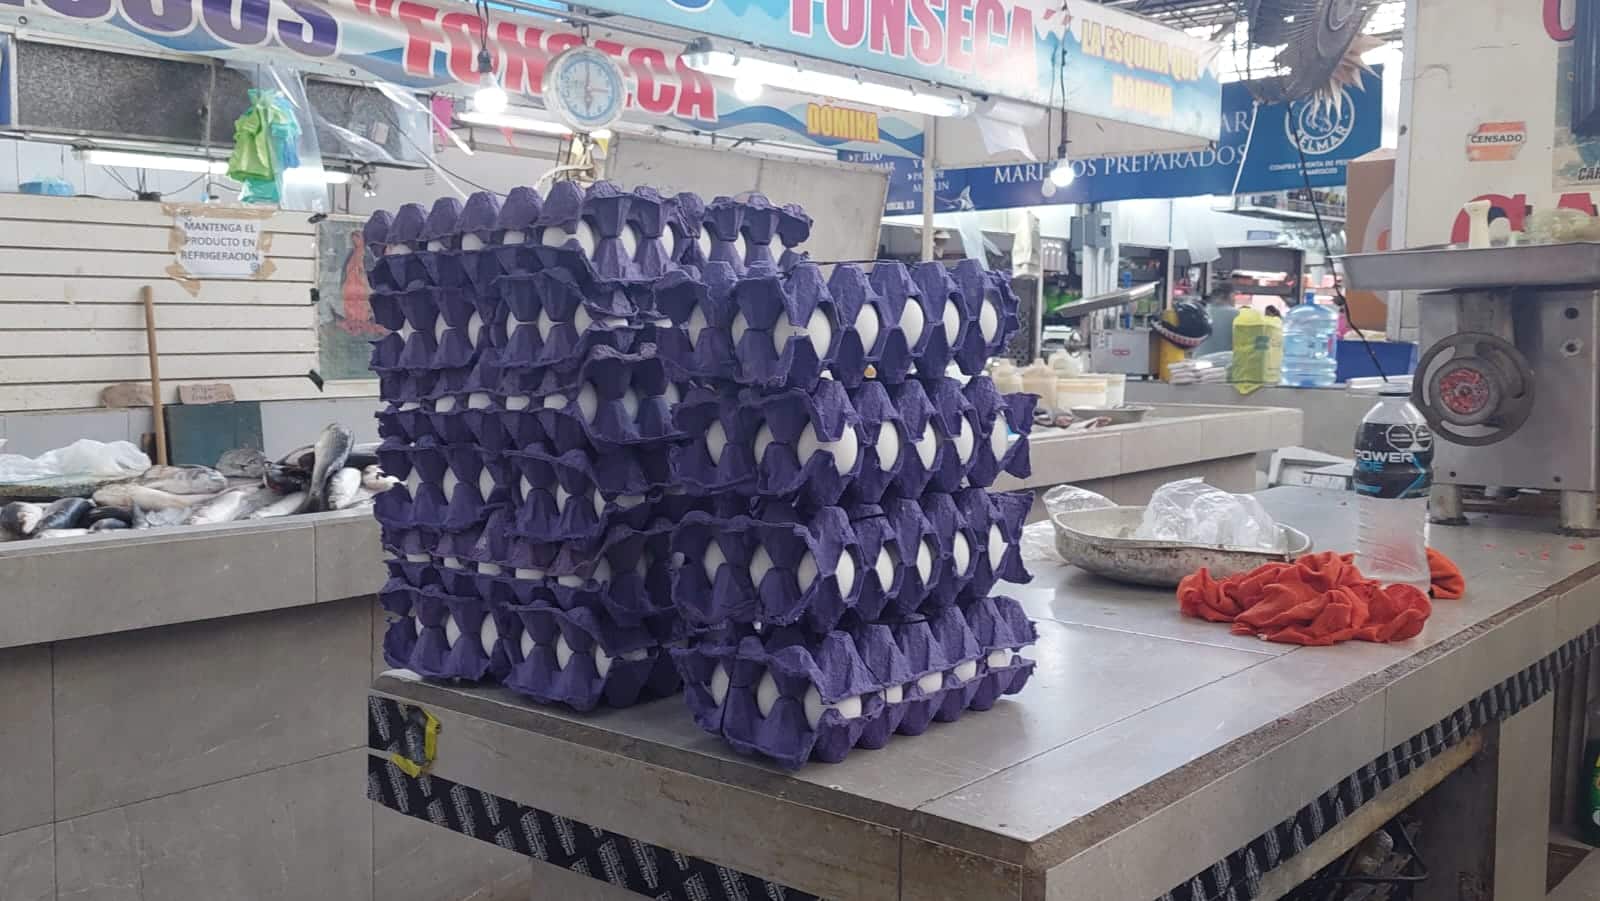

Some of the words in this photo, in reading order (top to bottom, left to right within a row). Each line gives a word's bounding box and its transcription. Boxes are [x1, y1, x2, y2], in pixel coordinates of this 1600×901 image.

[1081, 18, 1102, 57] LA
[1103, 25, 1169, 75] ESQUINA
[807, 102, 879, 143] DOMINA
[1471, 134, 1523, 144] CENSADO
[993, 159, 1097, 184] MARIOS
[1104, 144, 1247, 176] PREPARADOS
[184, 222, 242, 233] MANTENGA
[244, 223, 256, 233] EL
[242, 238, 256, 247] EN
[1354, 448, 1414, 464] POWER
